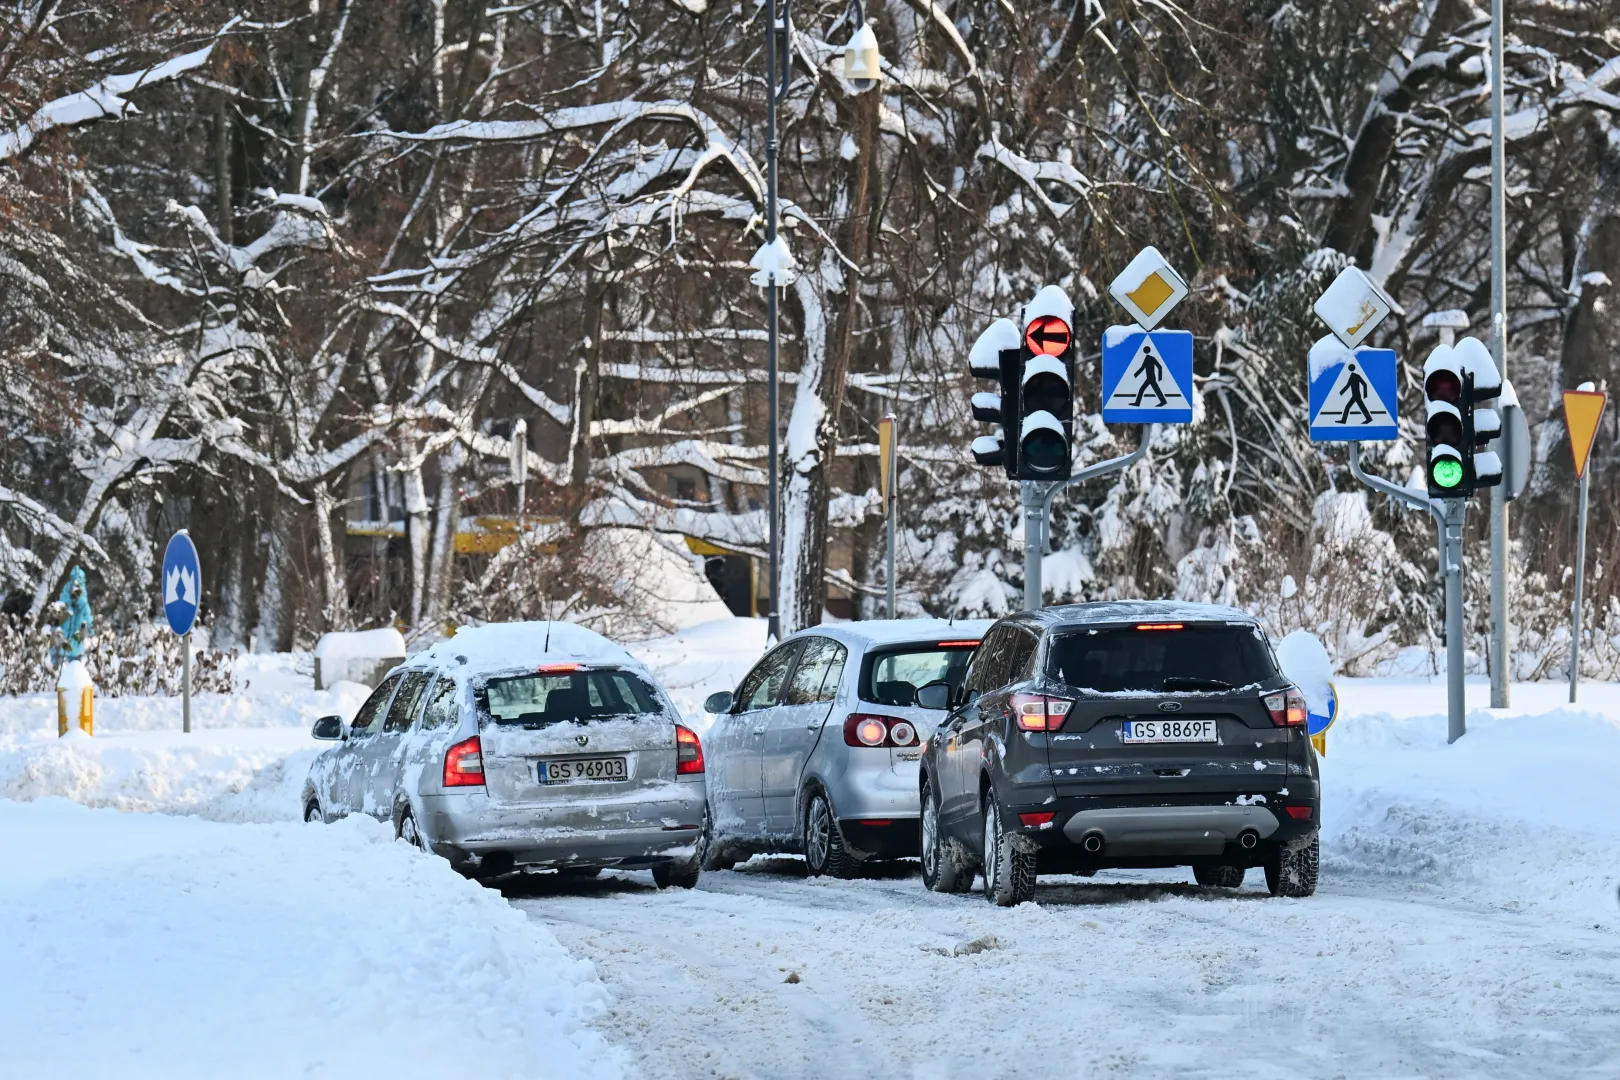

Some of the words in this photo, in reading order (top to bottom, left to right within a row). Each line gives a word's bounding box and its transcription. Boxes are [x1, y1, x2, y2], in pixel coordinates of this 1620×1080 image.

[1134, 723, 1156, 738] GS
[1162, 722, 1212, 738] 8869F
[548, 763, 571, 779] GS
[576, 760, 623, 777] 96903
